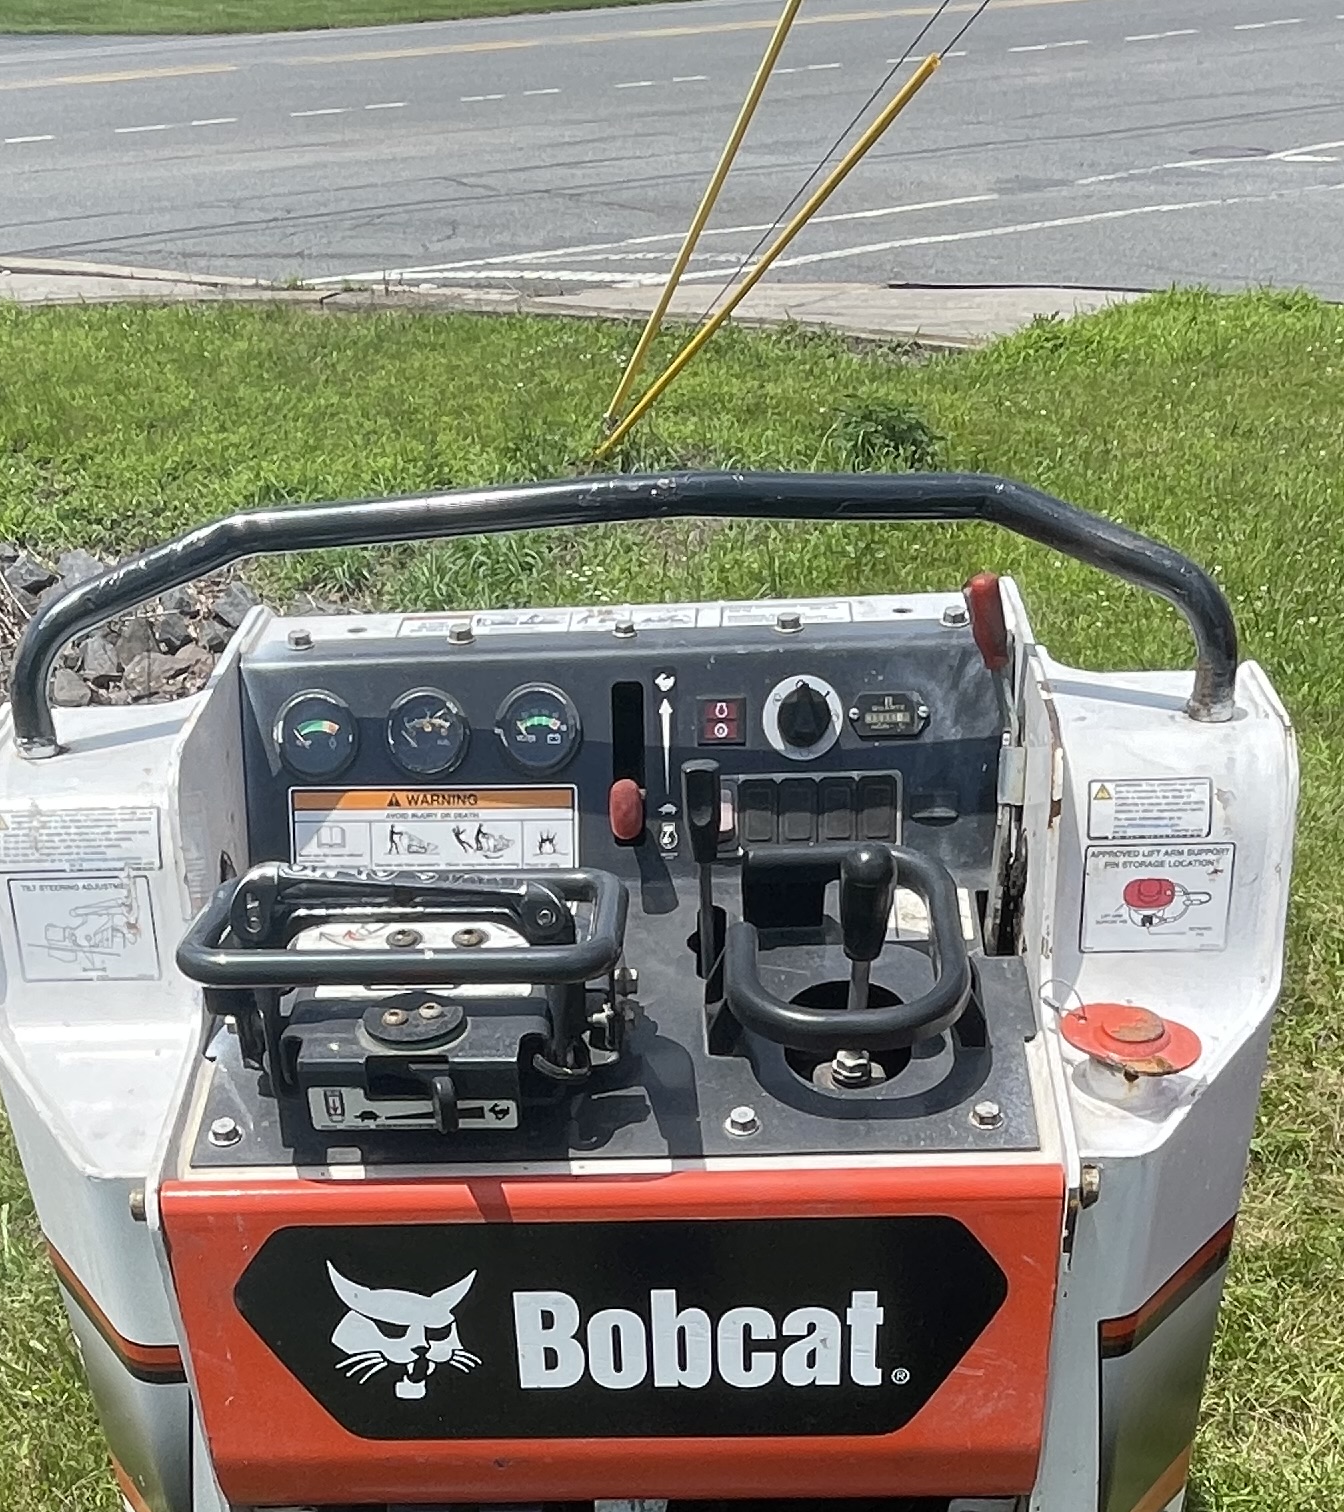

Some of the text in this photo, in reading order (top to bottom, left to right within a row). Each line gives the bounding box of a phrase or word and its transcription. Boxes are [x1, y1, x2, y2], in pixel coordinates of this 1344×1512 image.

[406, 793, 479, 807] WARNING
[1090, 847, 1230, 858] APPROVED LIFT ARM SUPPORT
[1122, 860, 1165, 869] STORAGE
[1168, 859, 1216, 868] LOCATION
[513, 1288, 884, 1389] Bobcat
